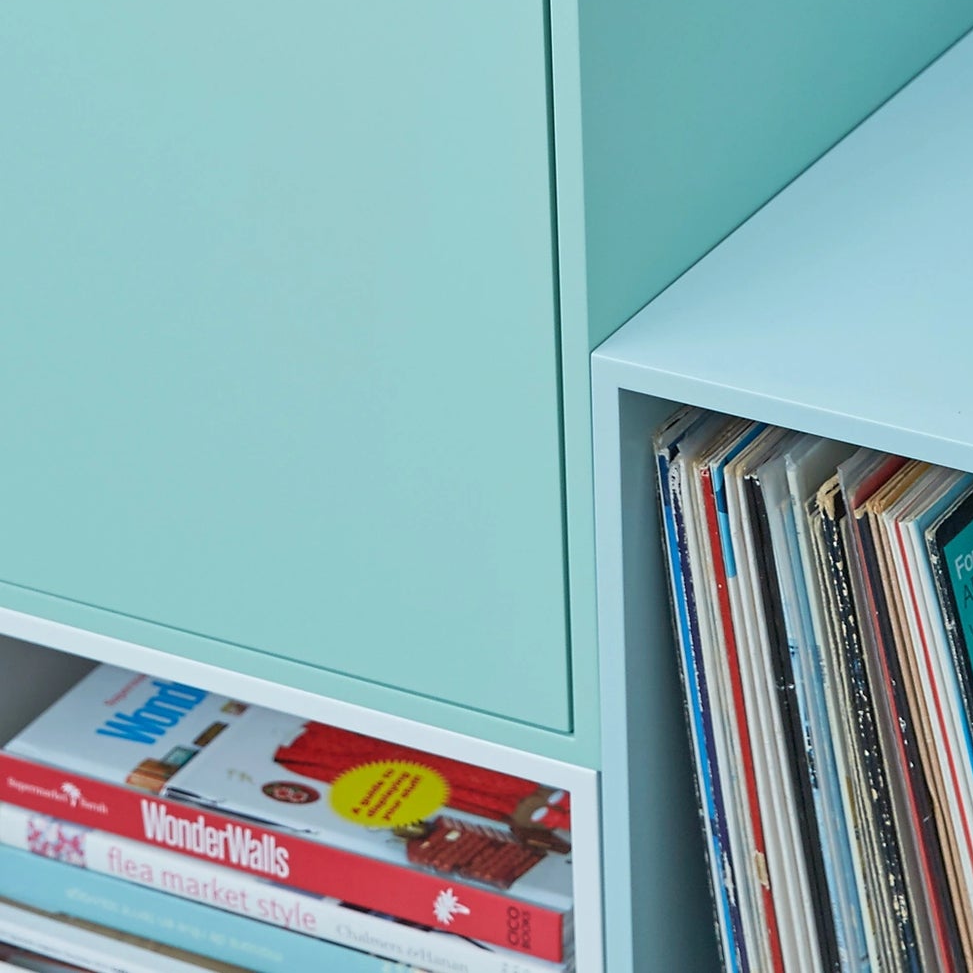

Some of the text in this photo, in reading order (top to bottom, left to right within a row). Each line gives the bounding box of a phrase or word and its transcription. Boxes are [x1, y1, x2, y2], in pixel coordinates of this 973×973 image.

[141, 799, 290, 879] WonderWalls
[107, 845, 154, 884] flea
[160, 869, 250, 913] market
[257, 898, 318, 931] style
[507, 905, 520, 946] CICO
